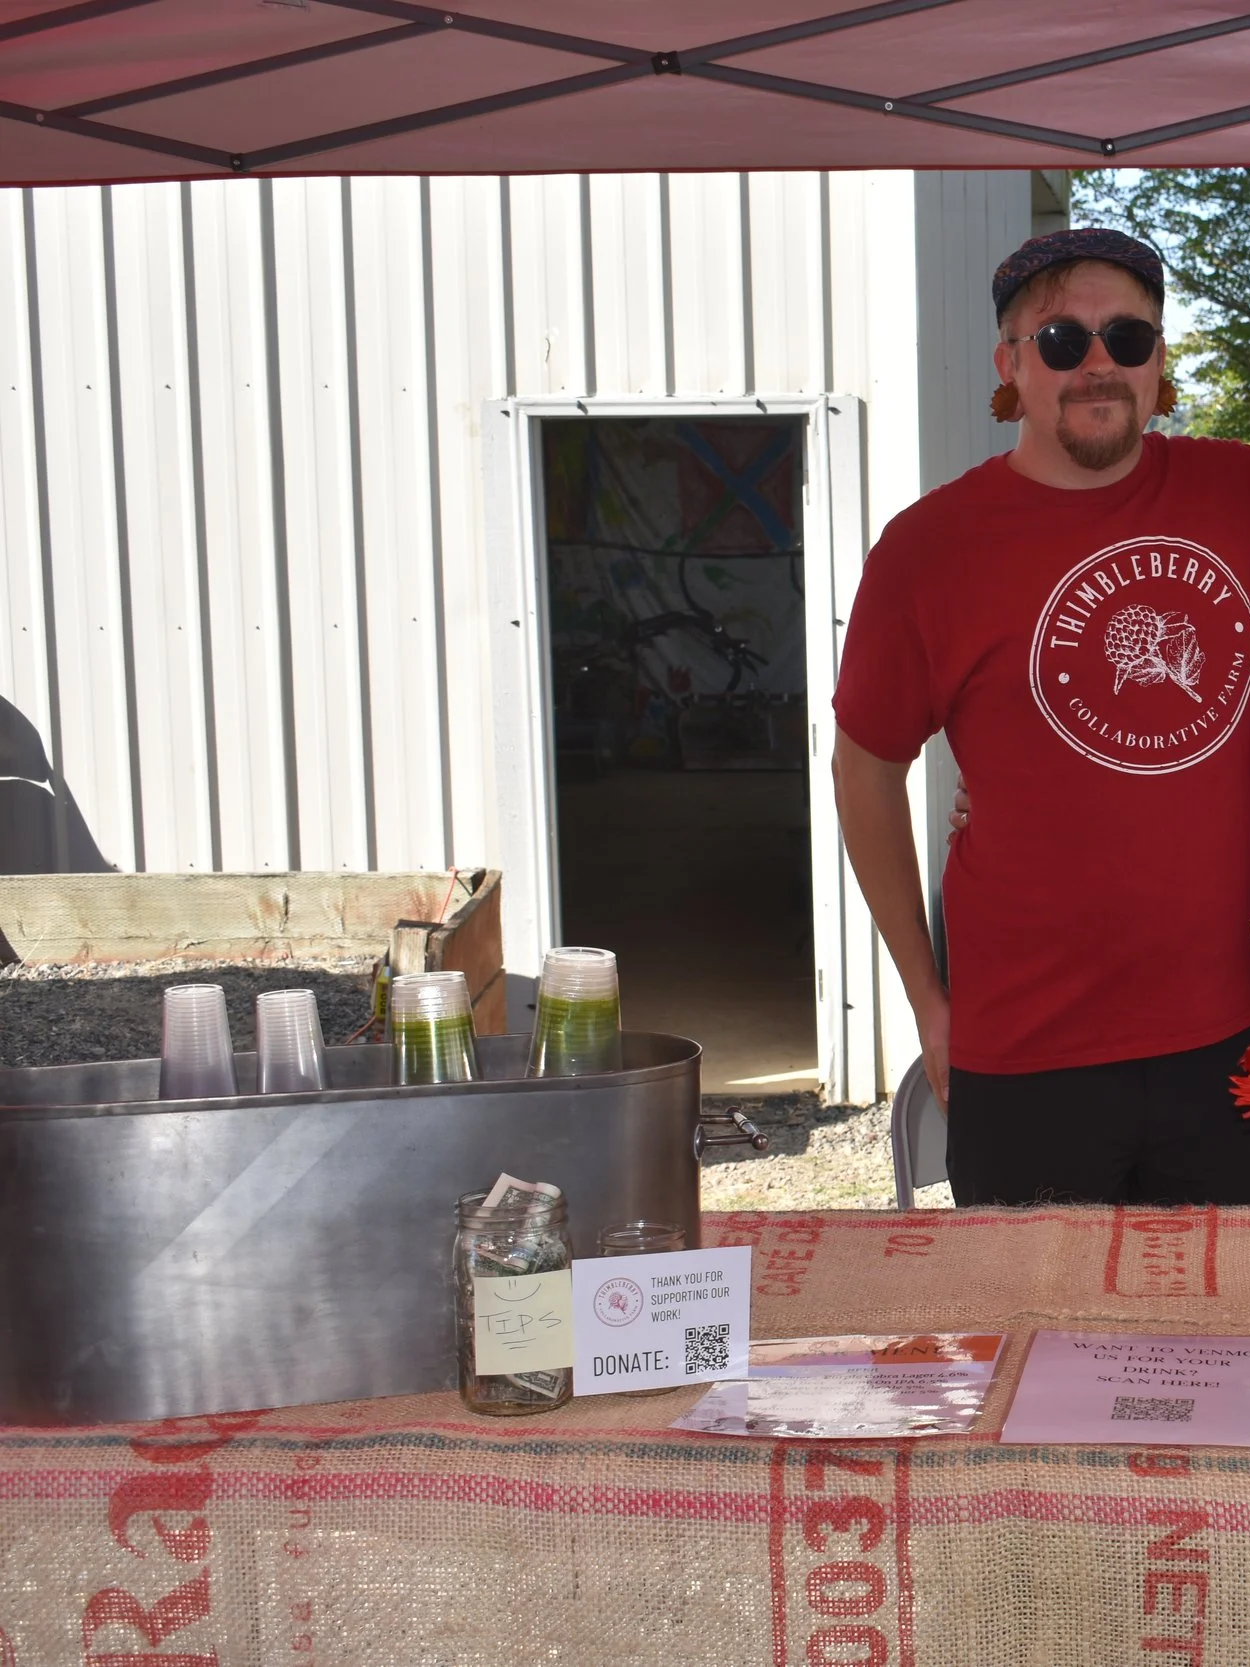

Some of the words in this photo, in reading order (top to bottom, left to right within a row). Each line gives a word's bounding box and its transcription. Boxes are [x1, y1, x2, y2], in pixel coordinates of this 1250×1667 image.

[1050, 552, 1232, 649] THIMBLEBERRY
[1069, 697, 1219, 750] COLLABORATIVE
[1220, 650, 1246, 706] FARM
[651, 1275, 682, 1288] THANK
[684, 1273, 702, 1285] YOU
[705, 1270, 723, 1282] FOR
[651, 1289, 708, 1306] SUPPORTING
[711, 1287, 730, 1299] OUR
[479, 1310, 562, 1334] TIPS
[651, 1309, 681, 1322] WORK!
[1073, 1342, 1134, 1352] WANT
[1149, 1345, 1175, 1354] TO
[593, 1350, 669, 1377] DONATE:
[1093, 1353, 1119, 1361] US
[1127, 1355, 1166, 1363] FOR
[1176, 1357, 1232, 1367] YOUR
[902, 1372, 936, 1380] Lager
[1123, 1366, 1198, 1376] DRINK?
[1096, 1375, 1151, 1385] SCAN
[1161, 1379, 1221, 1388] HERE!
[1140, 1510, 1210, 1667] NET
